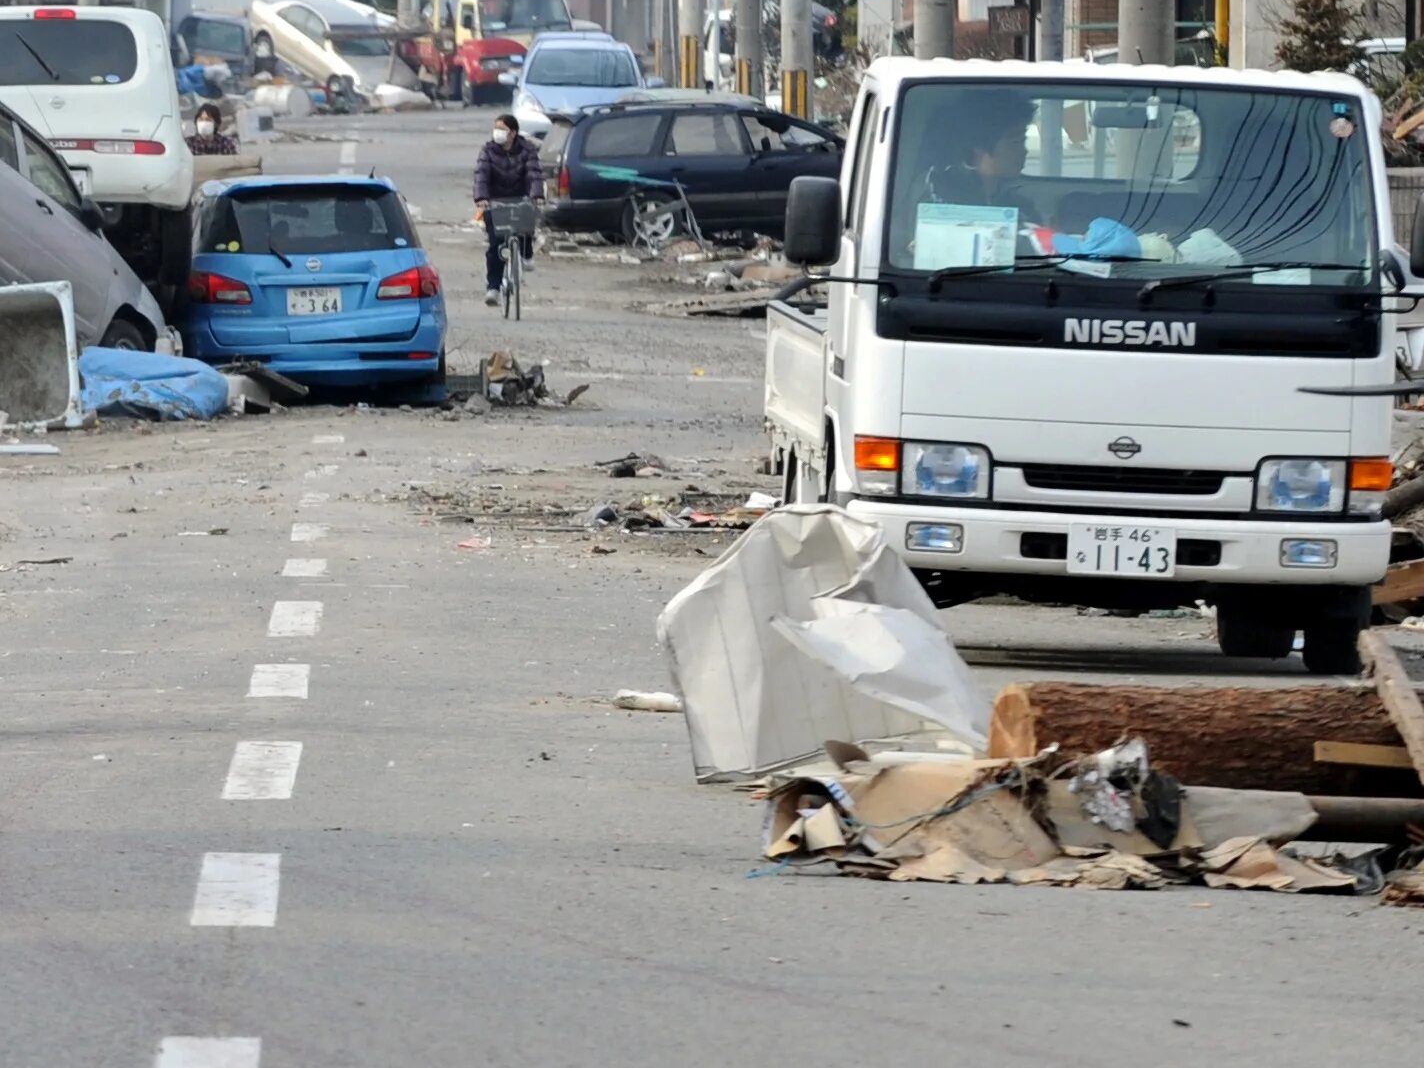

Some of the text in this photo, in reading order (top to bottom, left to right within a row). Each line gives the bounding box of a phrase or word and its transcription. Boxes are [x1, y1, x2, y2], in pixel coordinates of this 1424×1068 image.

[1064, 318, 1197, 347] NISSAN
[1094, 528, 1152, 543] 岩手 46
[1096, 544, 1170, 574] 11-43
